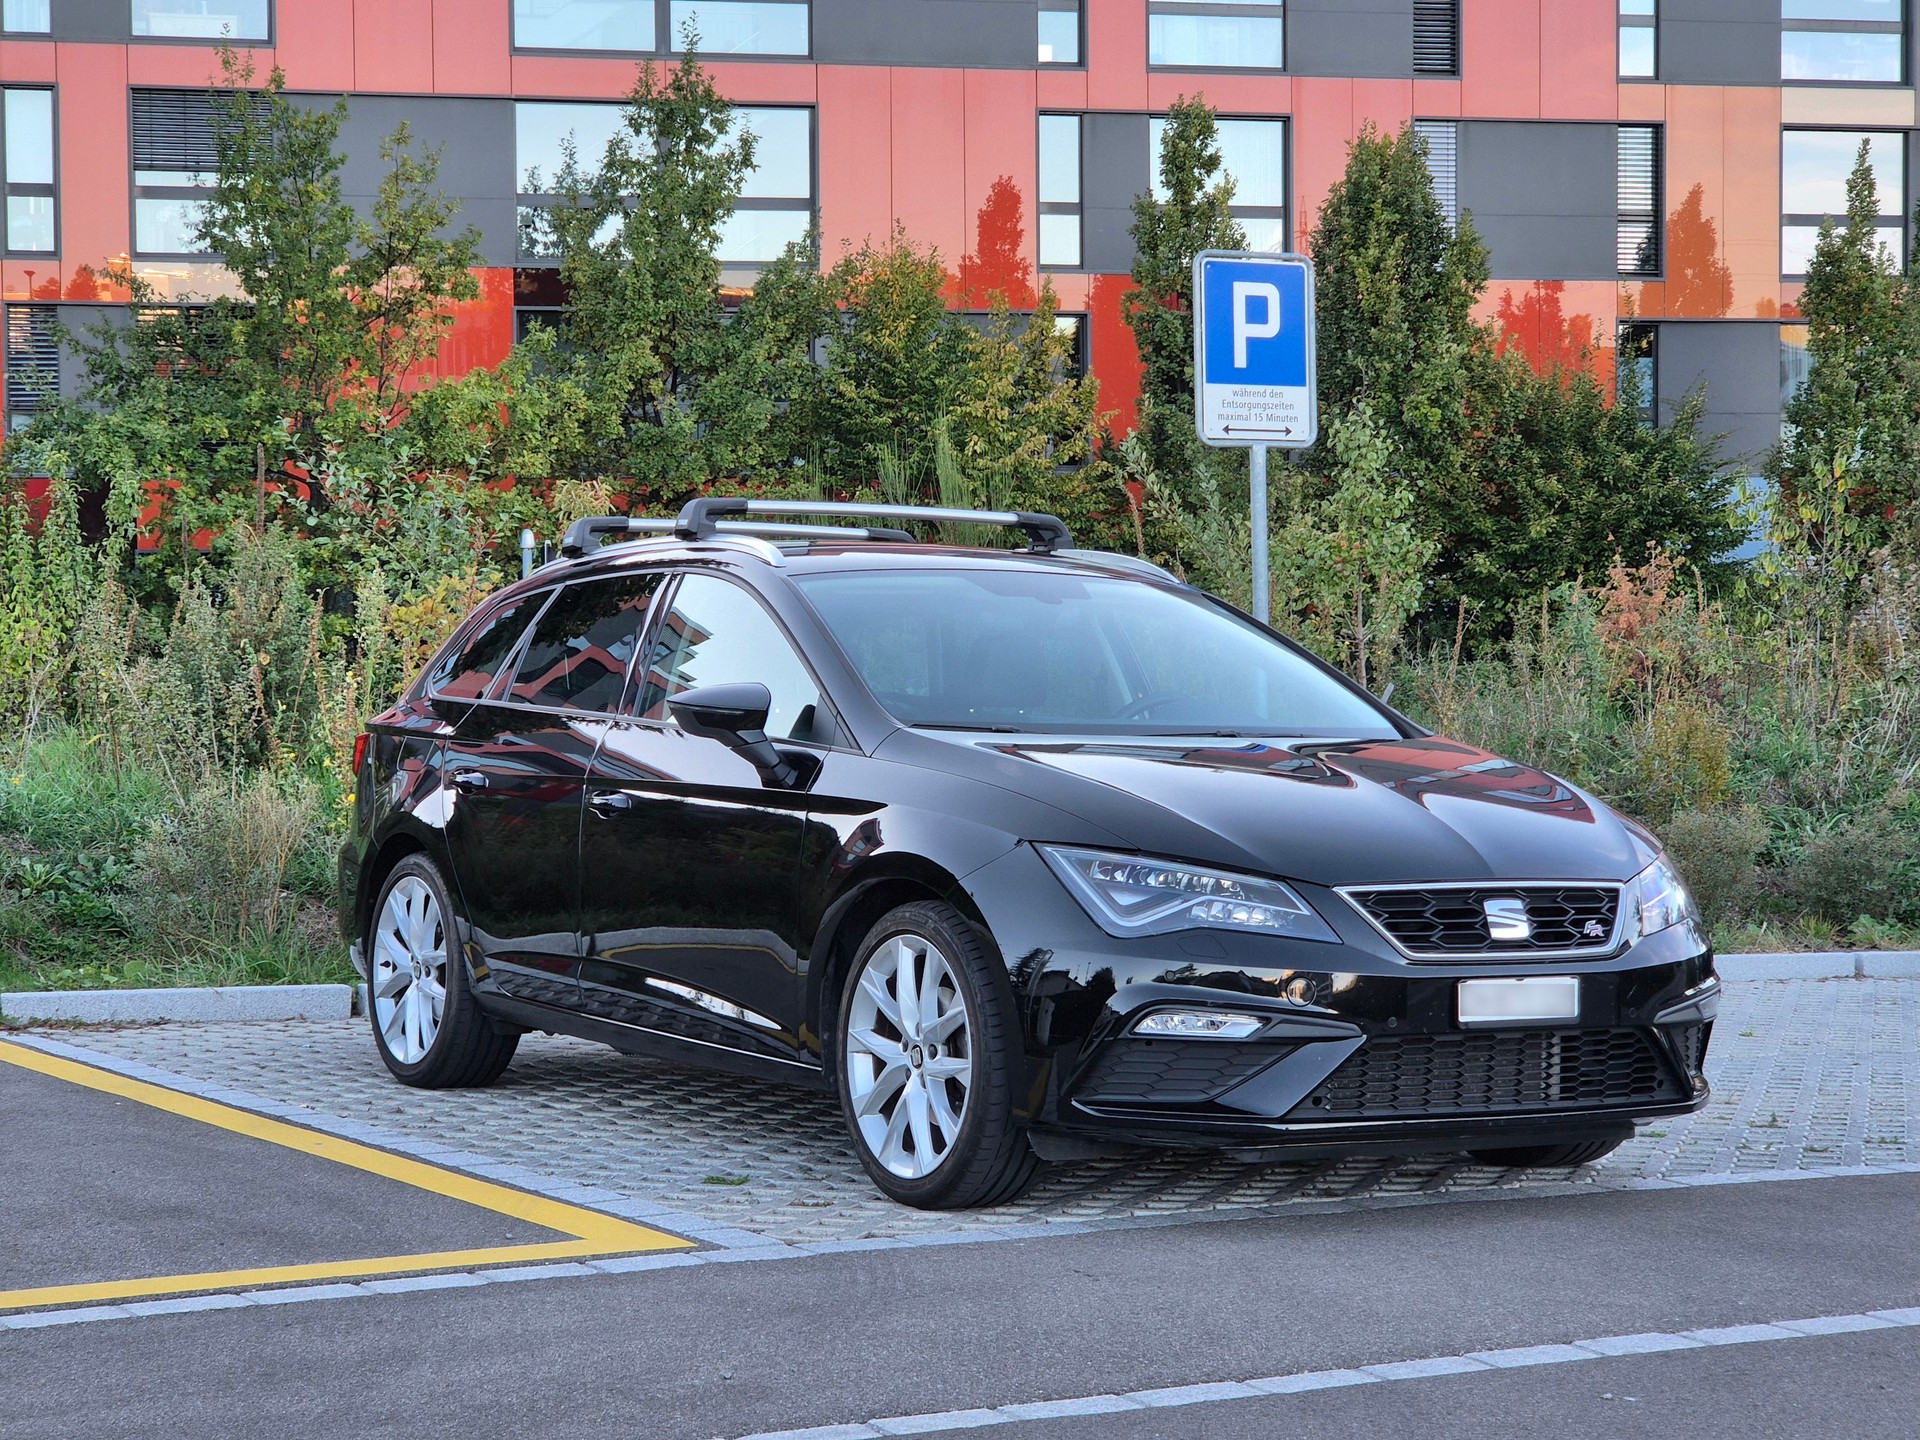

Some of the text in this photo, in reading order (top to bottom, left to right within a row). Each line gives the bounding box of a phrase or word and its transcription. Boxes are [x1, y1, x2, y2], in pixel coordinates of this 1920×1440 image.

[1233, 281, 1281, 369] P
[1232, 388, 1284, 399] während den
[1222, 399, 1295, 412] Entsorgungszeiten
[1217, 412, 1299, 423] maximal 15 Minuten
